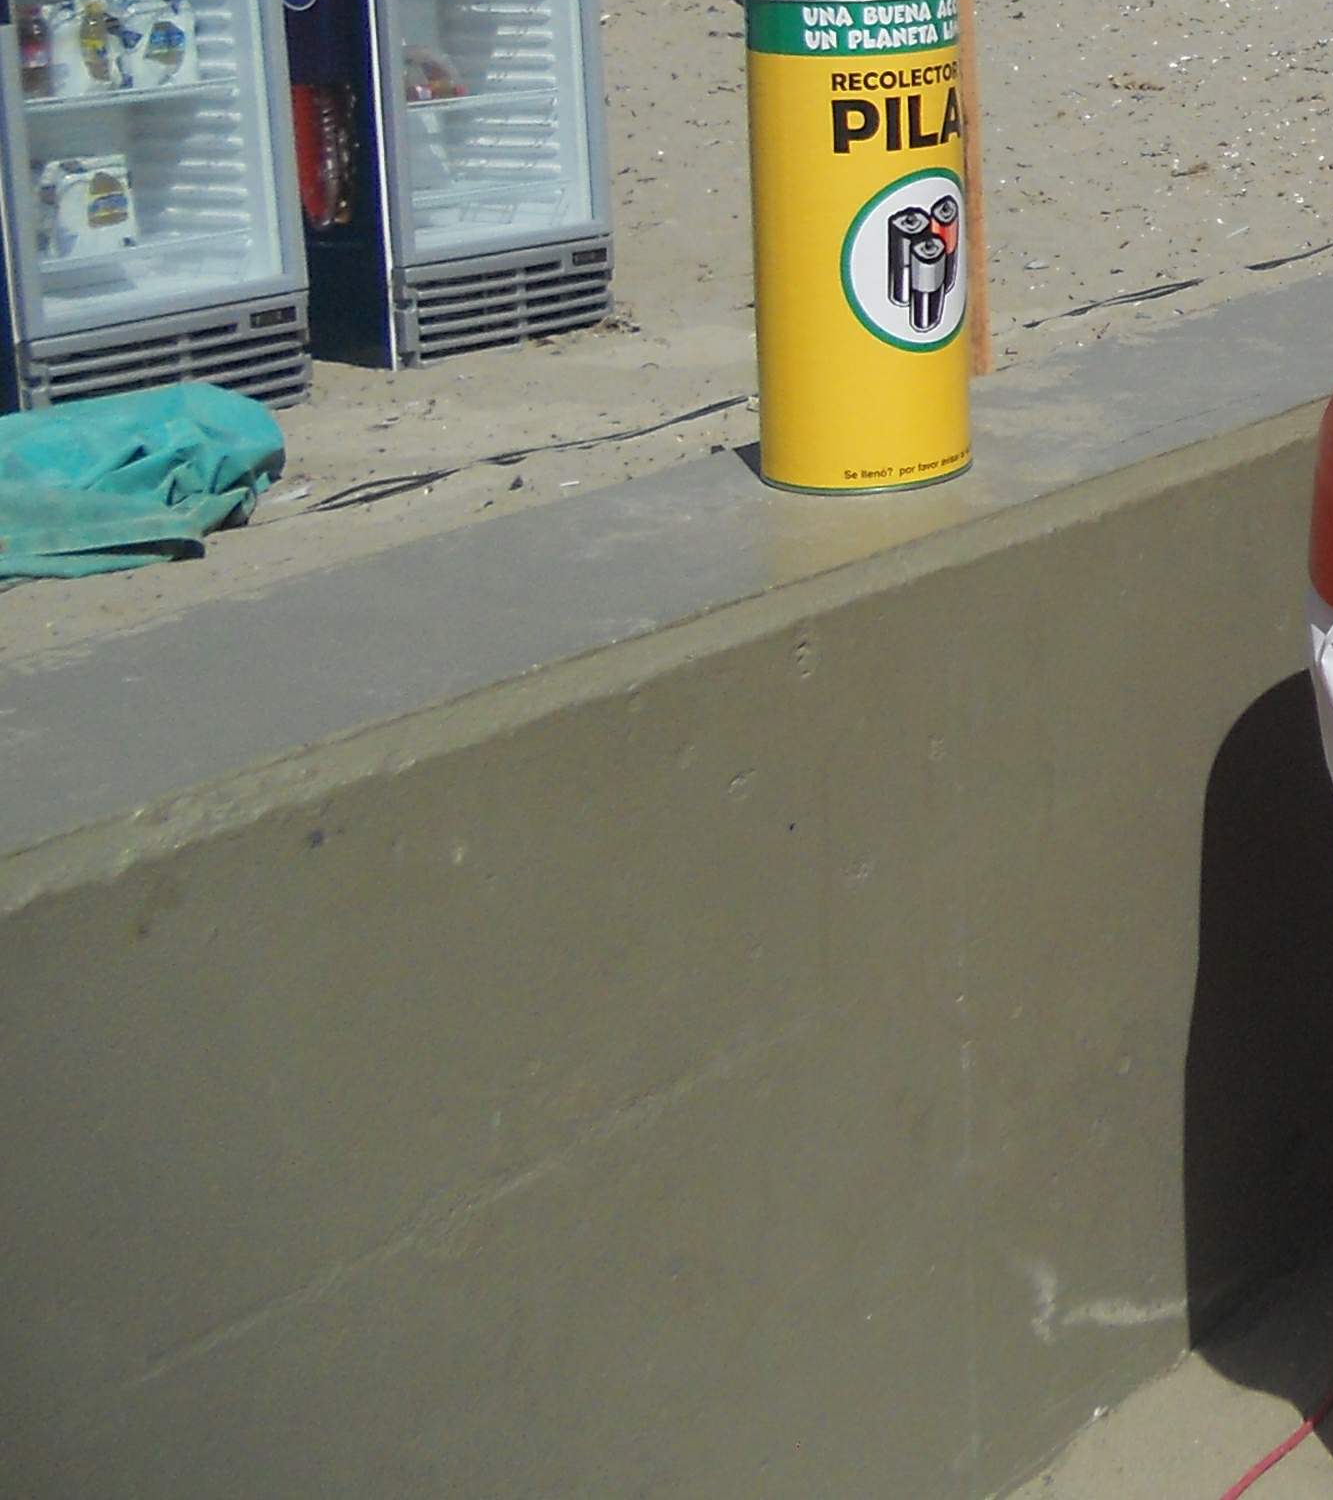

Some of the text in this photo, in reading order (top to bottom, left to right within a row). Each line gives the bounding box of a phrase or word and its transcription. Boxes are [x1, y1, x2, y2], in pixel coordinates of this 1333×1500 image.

[802, 6, 854, 27] UNA
[863, 1, 932, 26] BUENA
[804, 30, 838, 50] UN
[848, 24, 938, 50] PLANETA
[844, 470, 858, 481] Se
[899, 465, 916, 477] por
[917, 460, 939, 472] favor
